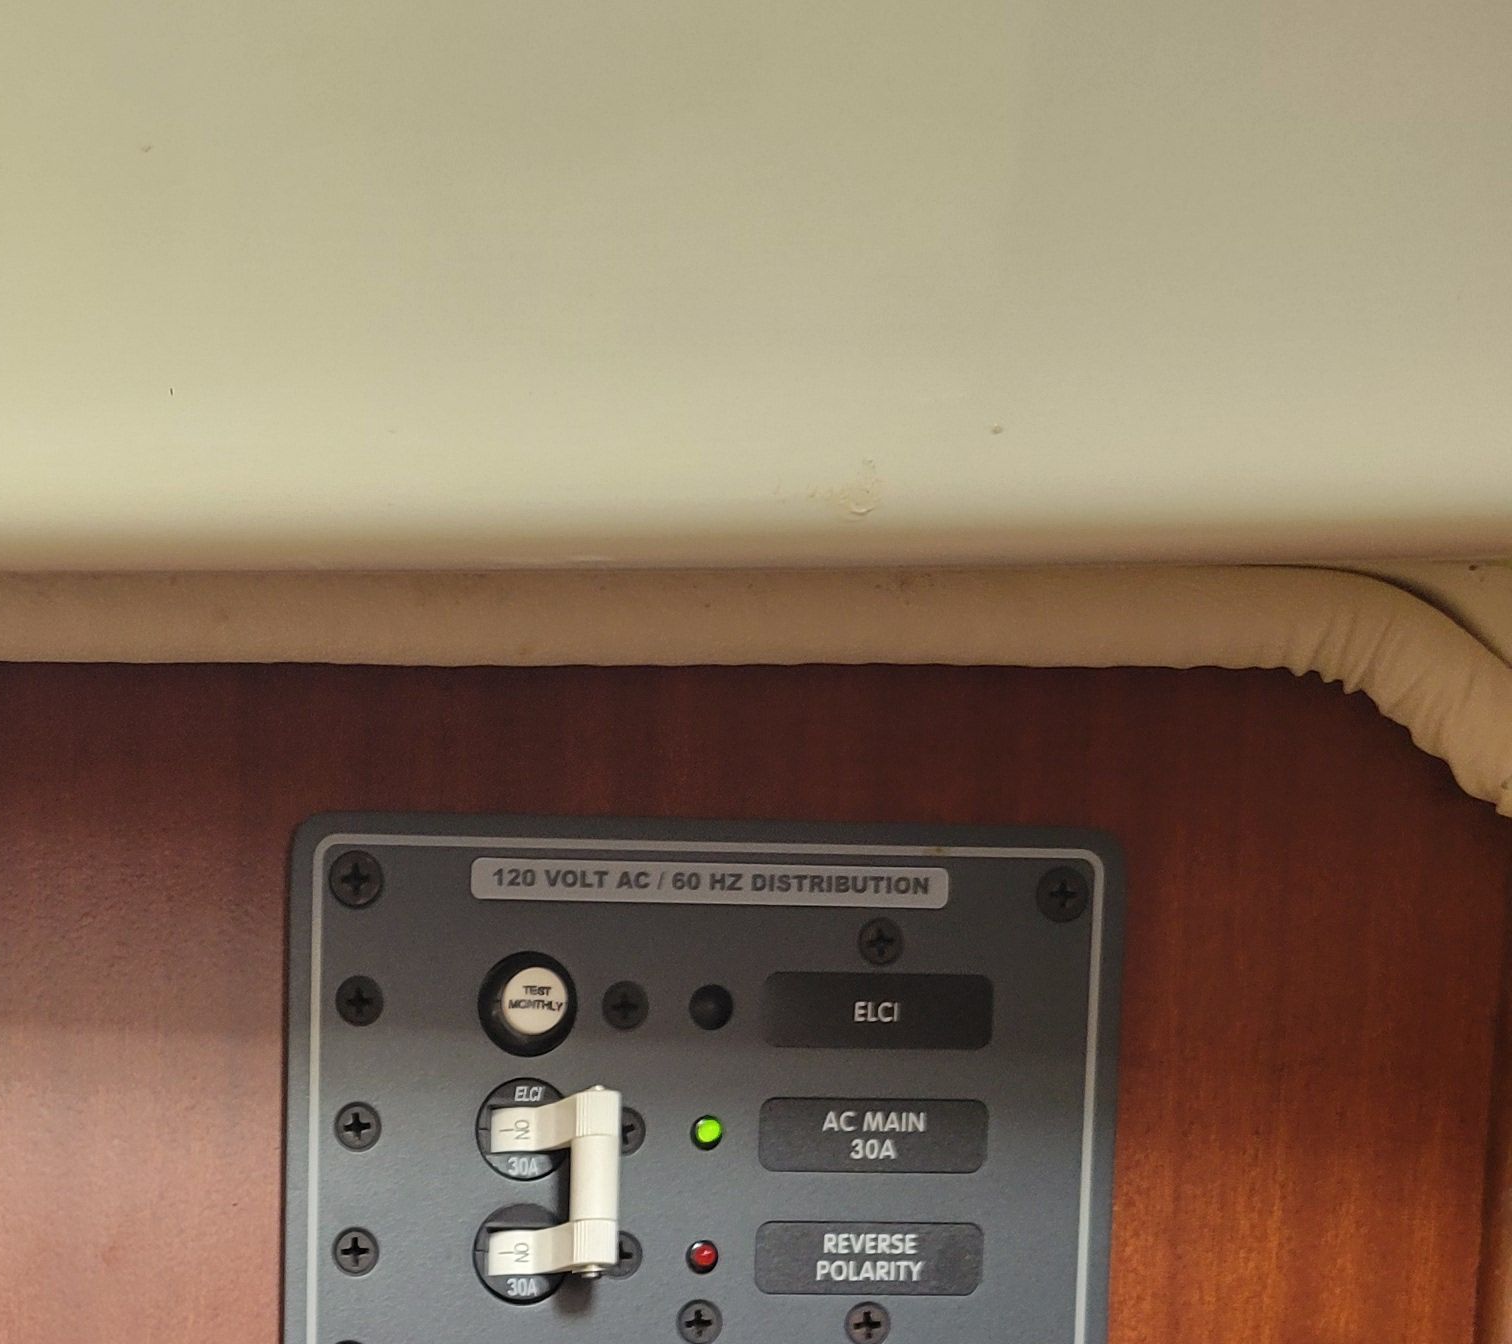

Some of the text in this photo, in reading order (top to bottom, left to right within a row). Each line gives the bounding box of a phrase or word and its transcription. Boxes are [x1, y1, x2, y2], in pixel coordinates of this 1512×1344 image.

[493, 868, 535, 886] 120
[545, 870, 608, 888] VOLT
[617, 871, 650, 889] AC
[672, 872, 700, 890] 60
[710, 873, 743, 891] HZ
[752, 874, 929, 894] DISTRIBUTION
[524, 986, 551, 995] TEST
[508, 999, 563, 1012] MONTHLY
[855, 1002, 898, 1022] ELCI
[515, 1086, 542, 1101] ELCI
[515, 1120, 529, 1140] ON
[822, 1111, 925, 1133] AC MAIN
[851, 1139, 895, 1159] 30A
[508, 1157, 539, 1175] 30A
[514, 1242, 529, 1263] ON
[824, 1234, 917, 1254] REVERSE
[816, 1261, 922, 1281] POLARITY
[507, 1278, 538, 1296] 30A
